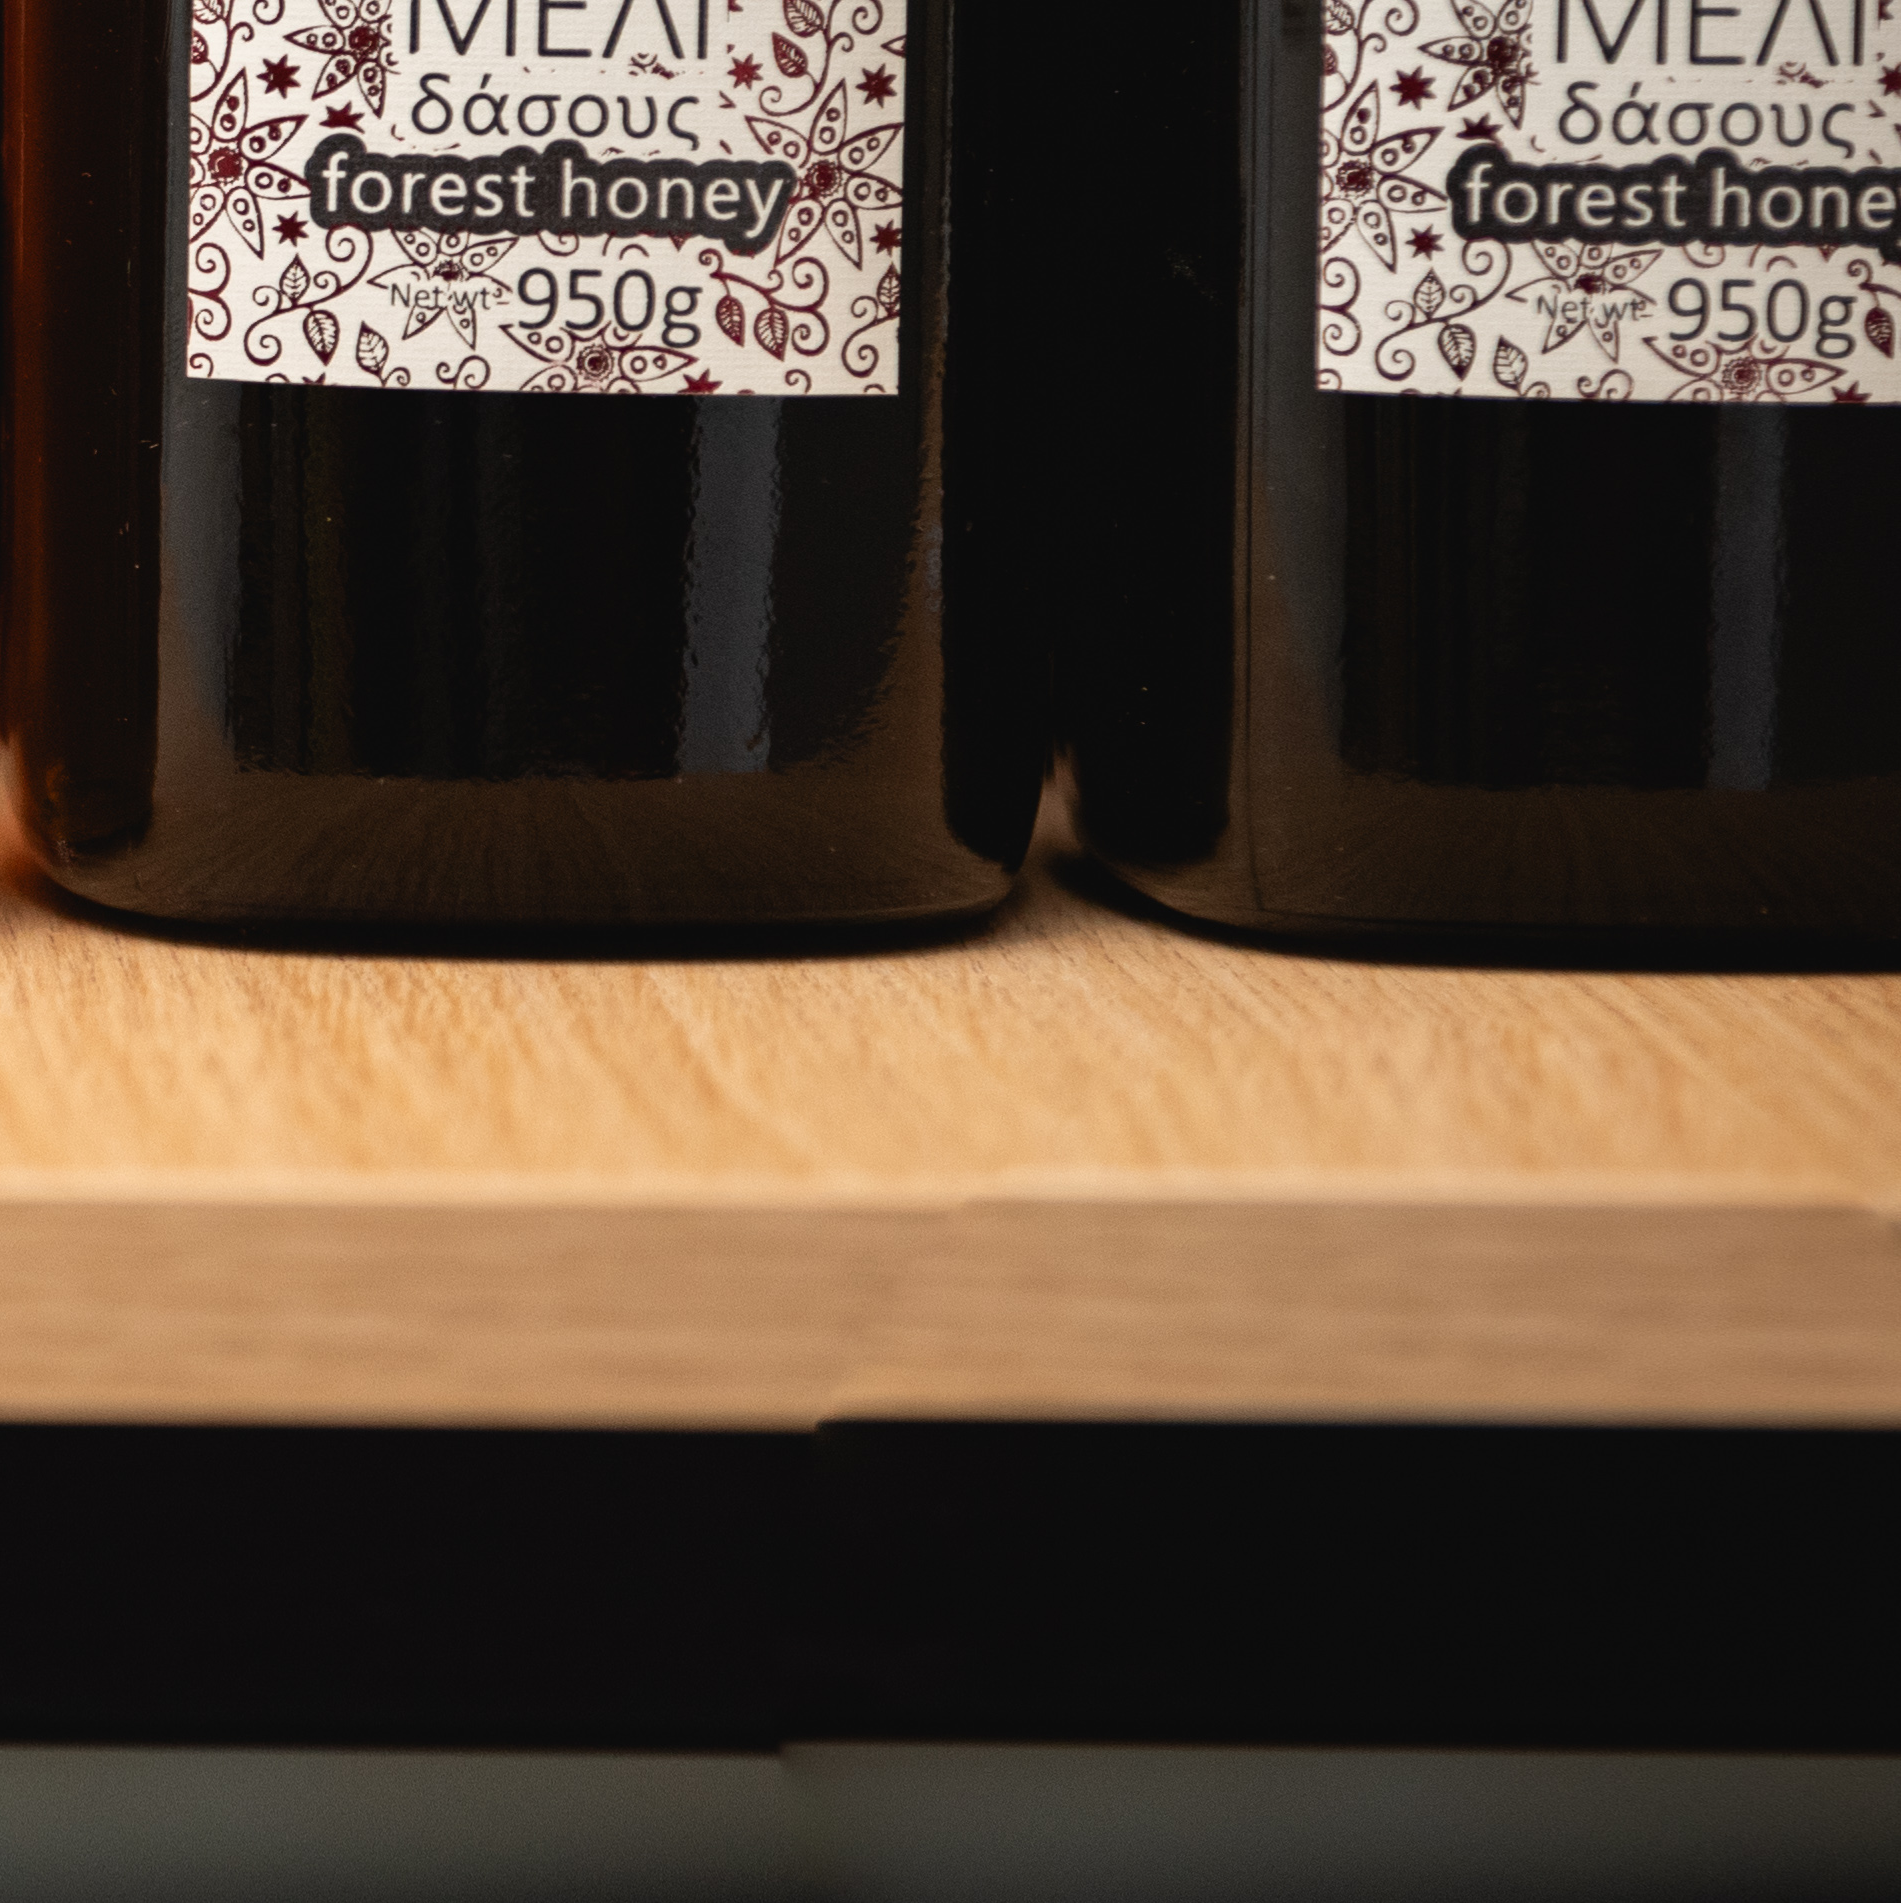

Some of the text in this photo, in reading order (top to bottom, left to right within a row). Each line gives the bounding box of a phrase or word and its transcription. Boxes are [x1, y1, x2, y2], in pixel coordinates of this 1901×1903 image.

[411, 73, 701, 149] δάσους
[1560, 83, 1854, 158] δάσους
[322, 151, 786, 240] forest honey
[1466, 162, 1901, 231] forest hone
[517, 268, 702, 348] 950g
[1668, 278, 1858, 358] 950g
